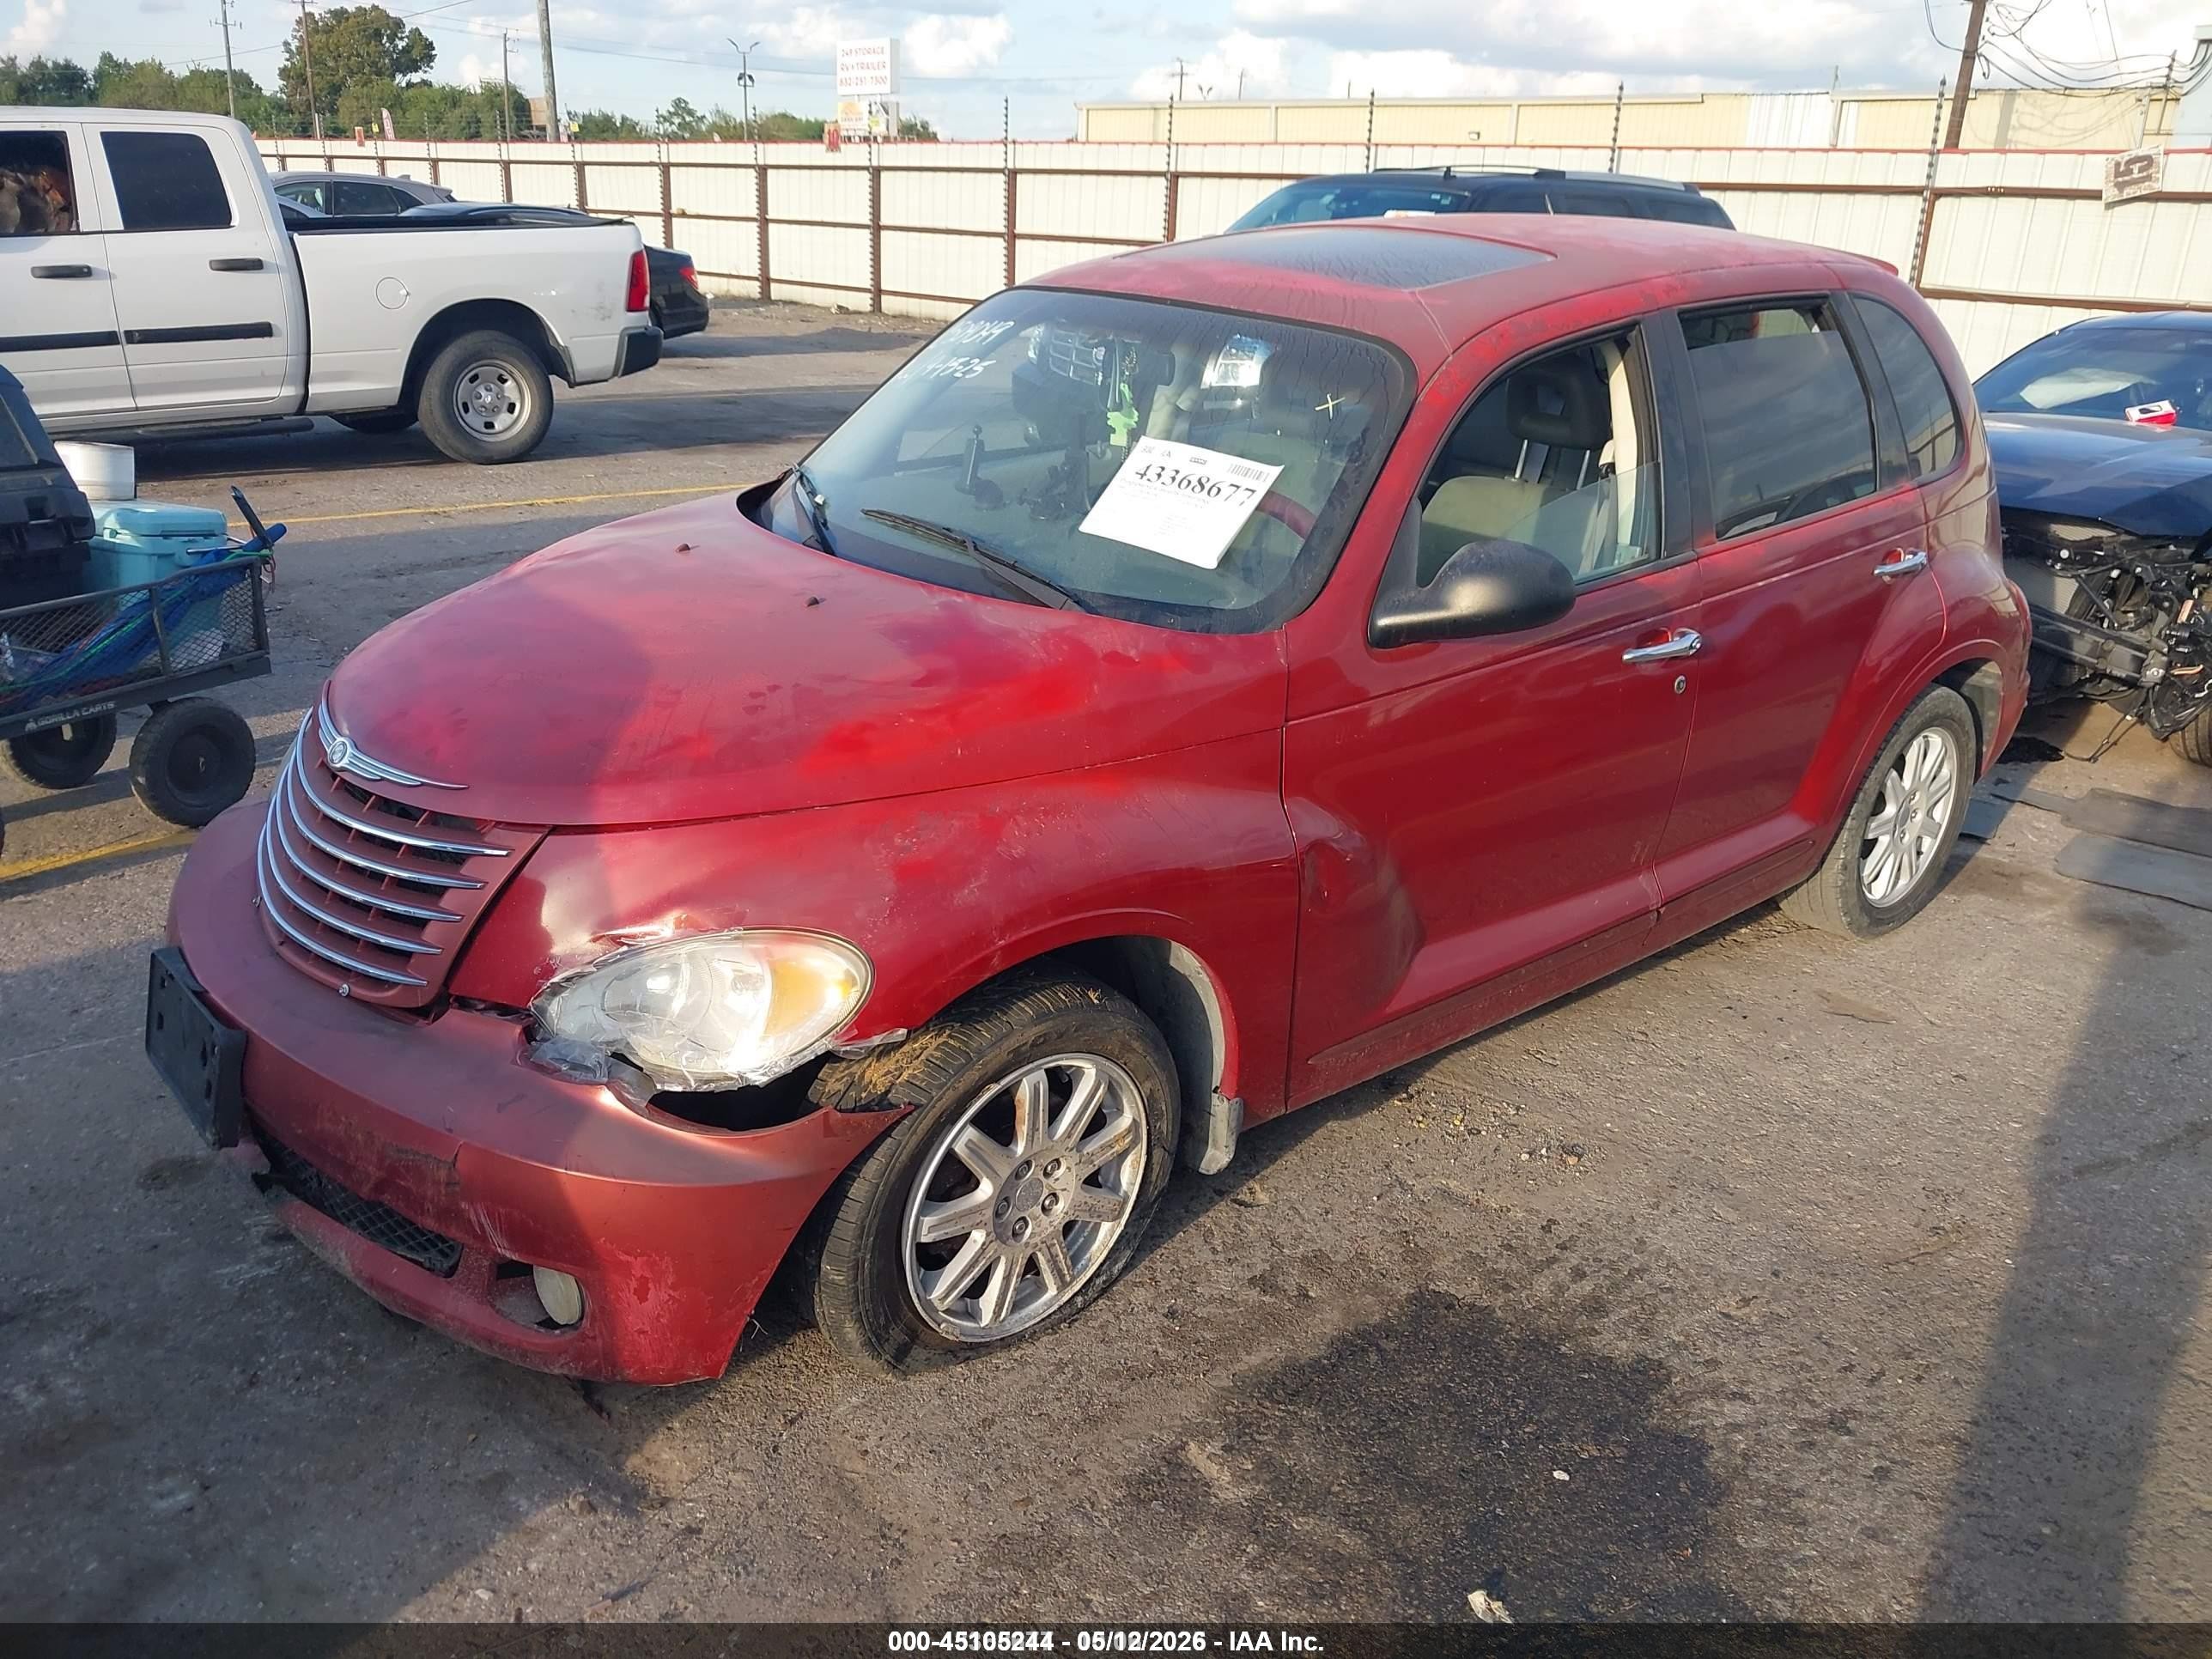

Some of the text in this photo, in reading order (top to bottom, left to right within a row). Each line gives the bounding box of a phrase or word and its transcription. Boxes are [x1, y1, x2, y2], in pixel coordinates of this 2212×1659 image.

[854, 46, 885, 57] STORAGE
[855, 61, 887, 70] TRAILER
[1134, 464, 1257, 507] 43368677
[37, 701, 115, 726] GORILLA CARTS
